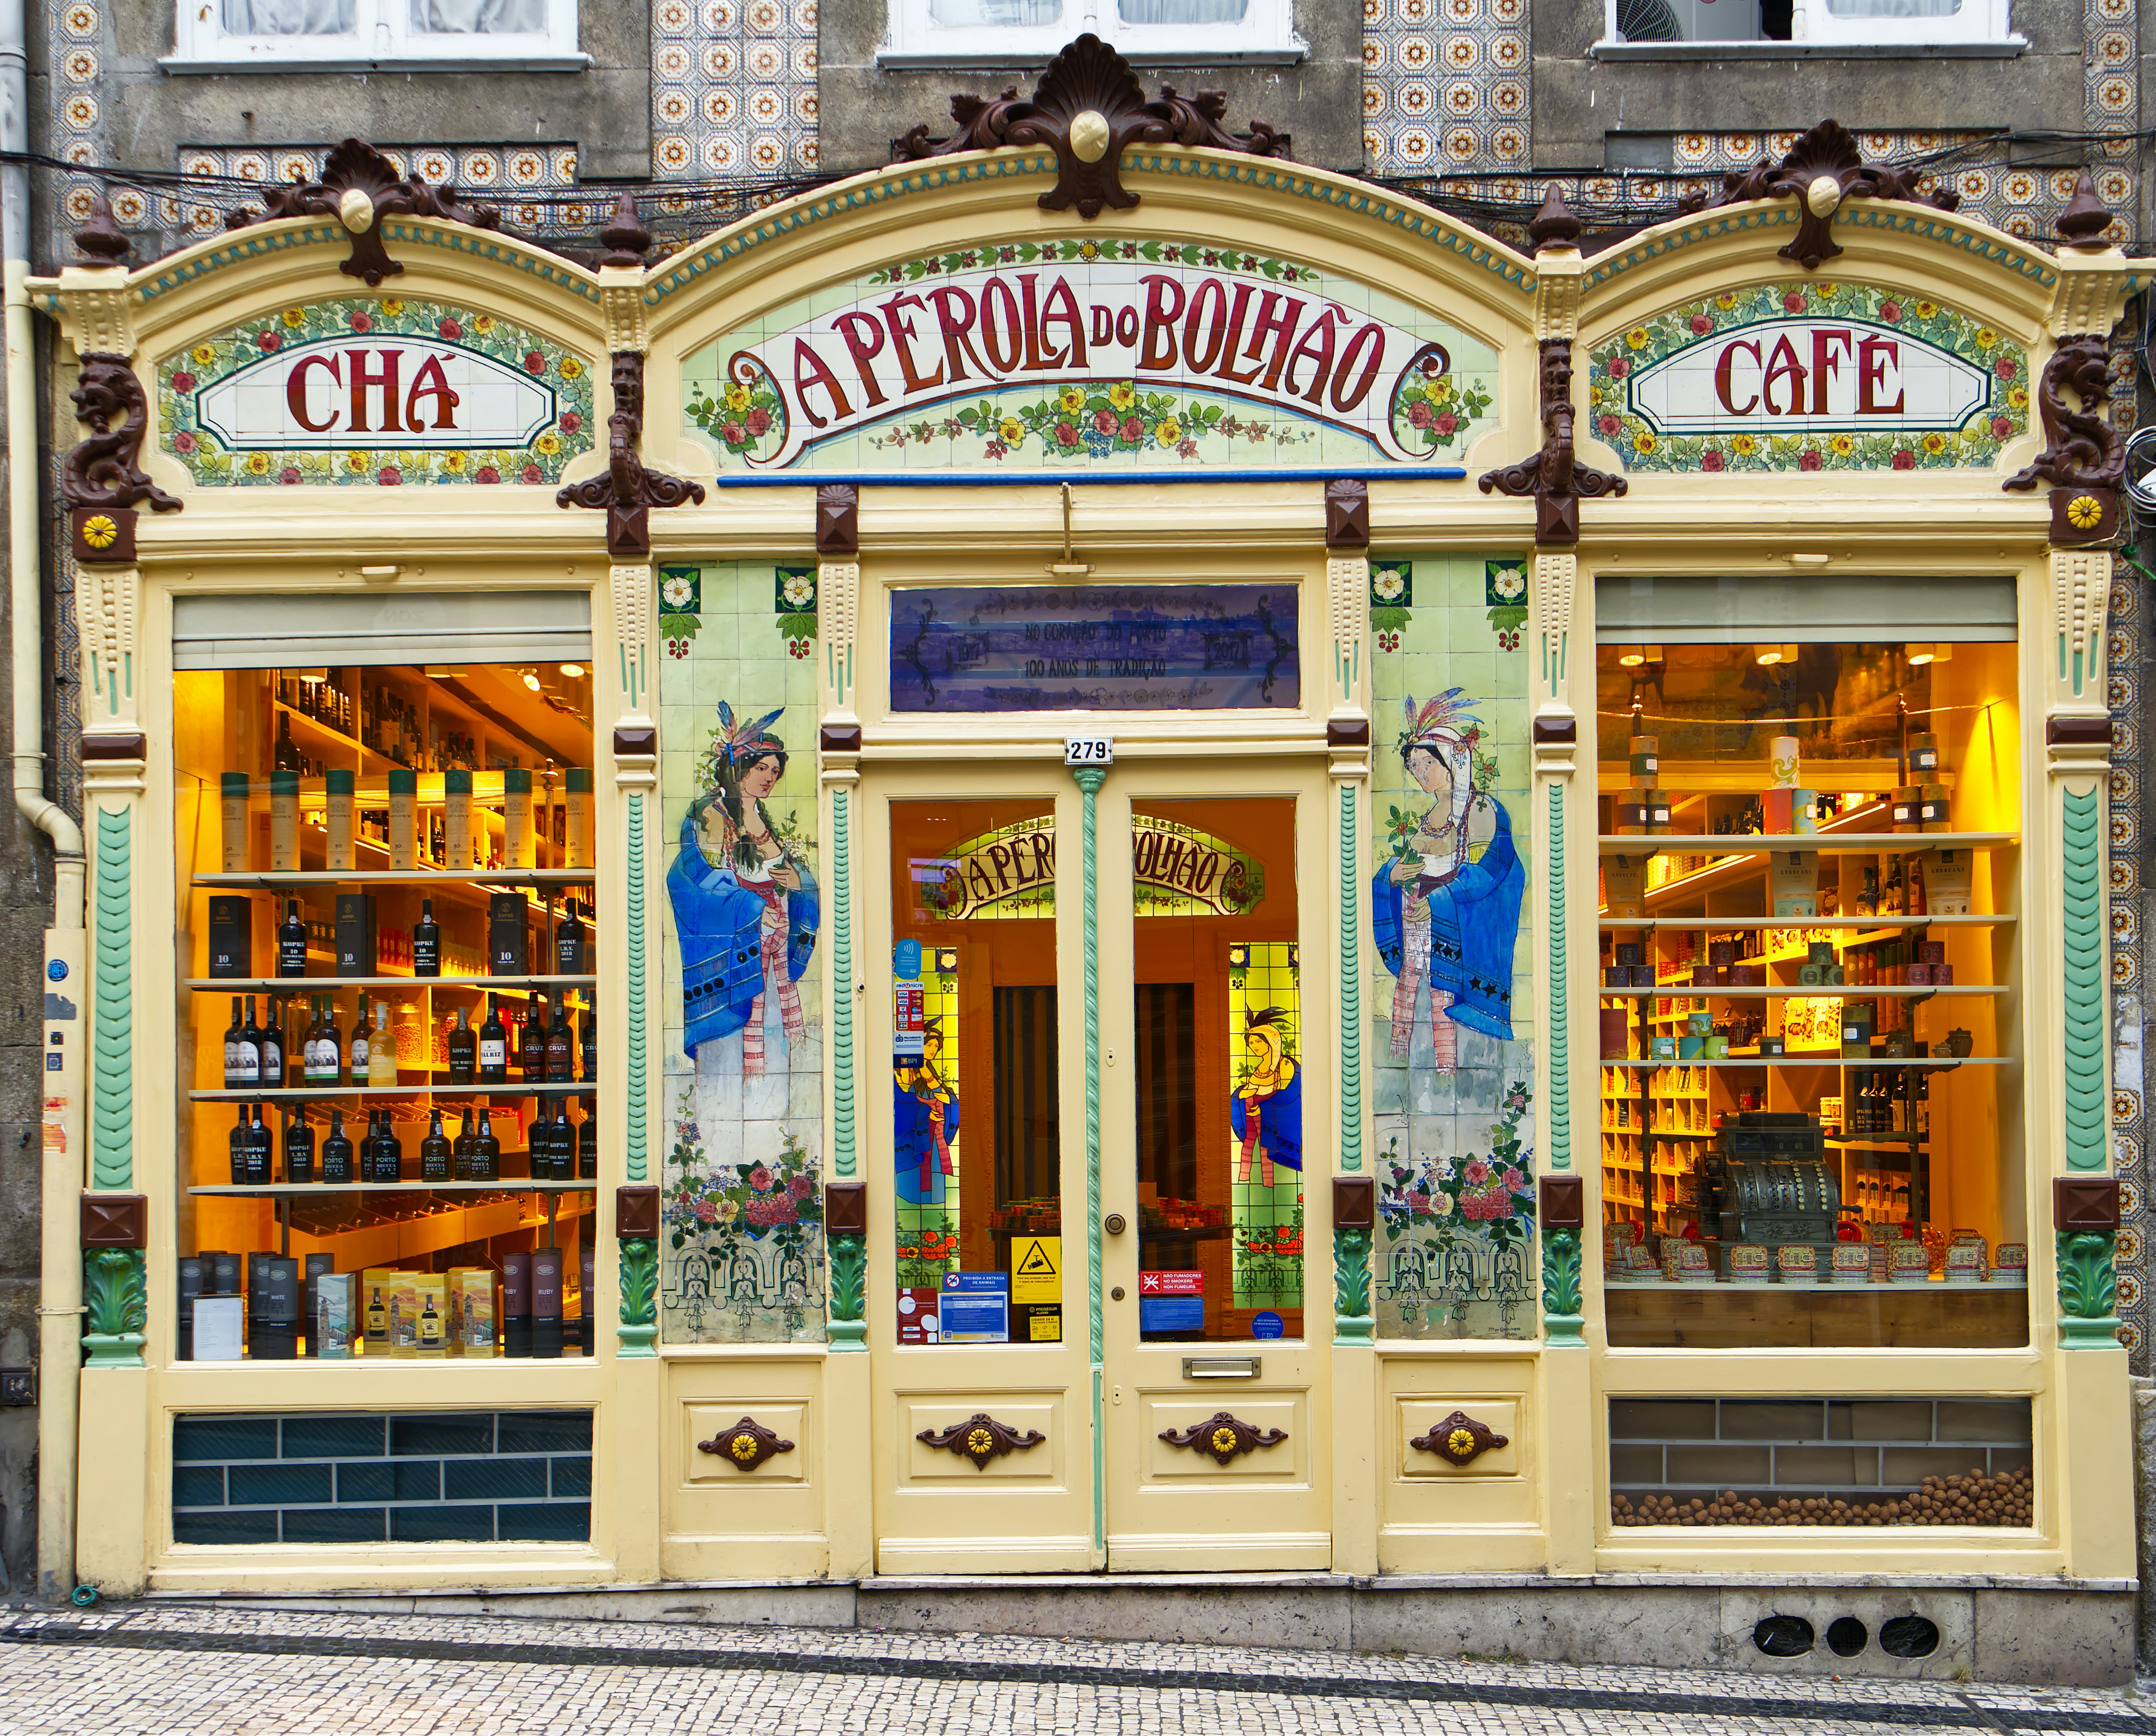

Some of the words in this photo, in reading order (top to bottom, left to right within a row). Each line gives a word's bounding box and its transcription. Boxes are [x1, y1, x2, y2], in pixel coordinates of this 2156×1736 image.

[793, 337, 854, 428] A
[830, 274, 1089, 408] PÉROLA
[1090, 305, 1136, 348] DO
[1136, 274, 1385, 412] BOLHÃO
[1715, 330, 1904, 415] CAFÉ
[287, 350, 459, 433] CHÁ
[1025, 624, 1040, 641] NO
[1045, 621, 1096, 643] CORAÇÃO
[1106, 624, 1122, 641] DO
[1025, 660, 1044, 677] 100
[1049, 659, 1078, 677] ANOS
[1087, 658, 1100, 676] DE
[1071, 742, 1106, 760] 279
[969, 856, 995, 900] A
[986, 830, 1055, 891] PÉR
[1133, 831, 1218, 894] OLHÃO
[218, 955, 229, 963] 10
[345, 953, 353, 961] 10
[501, 952, 512, 960] 10
